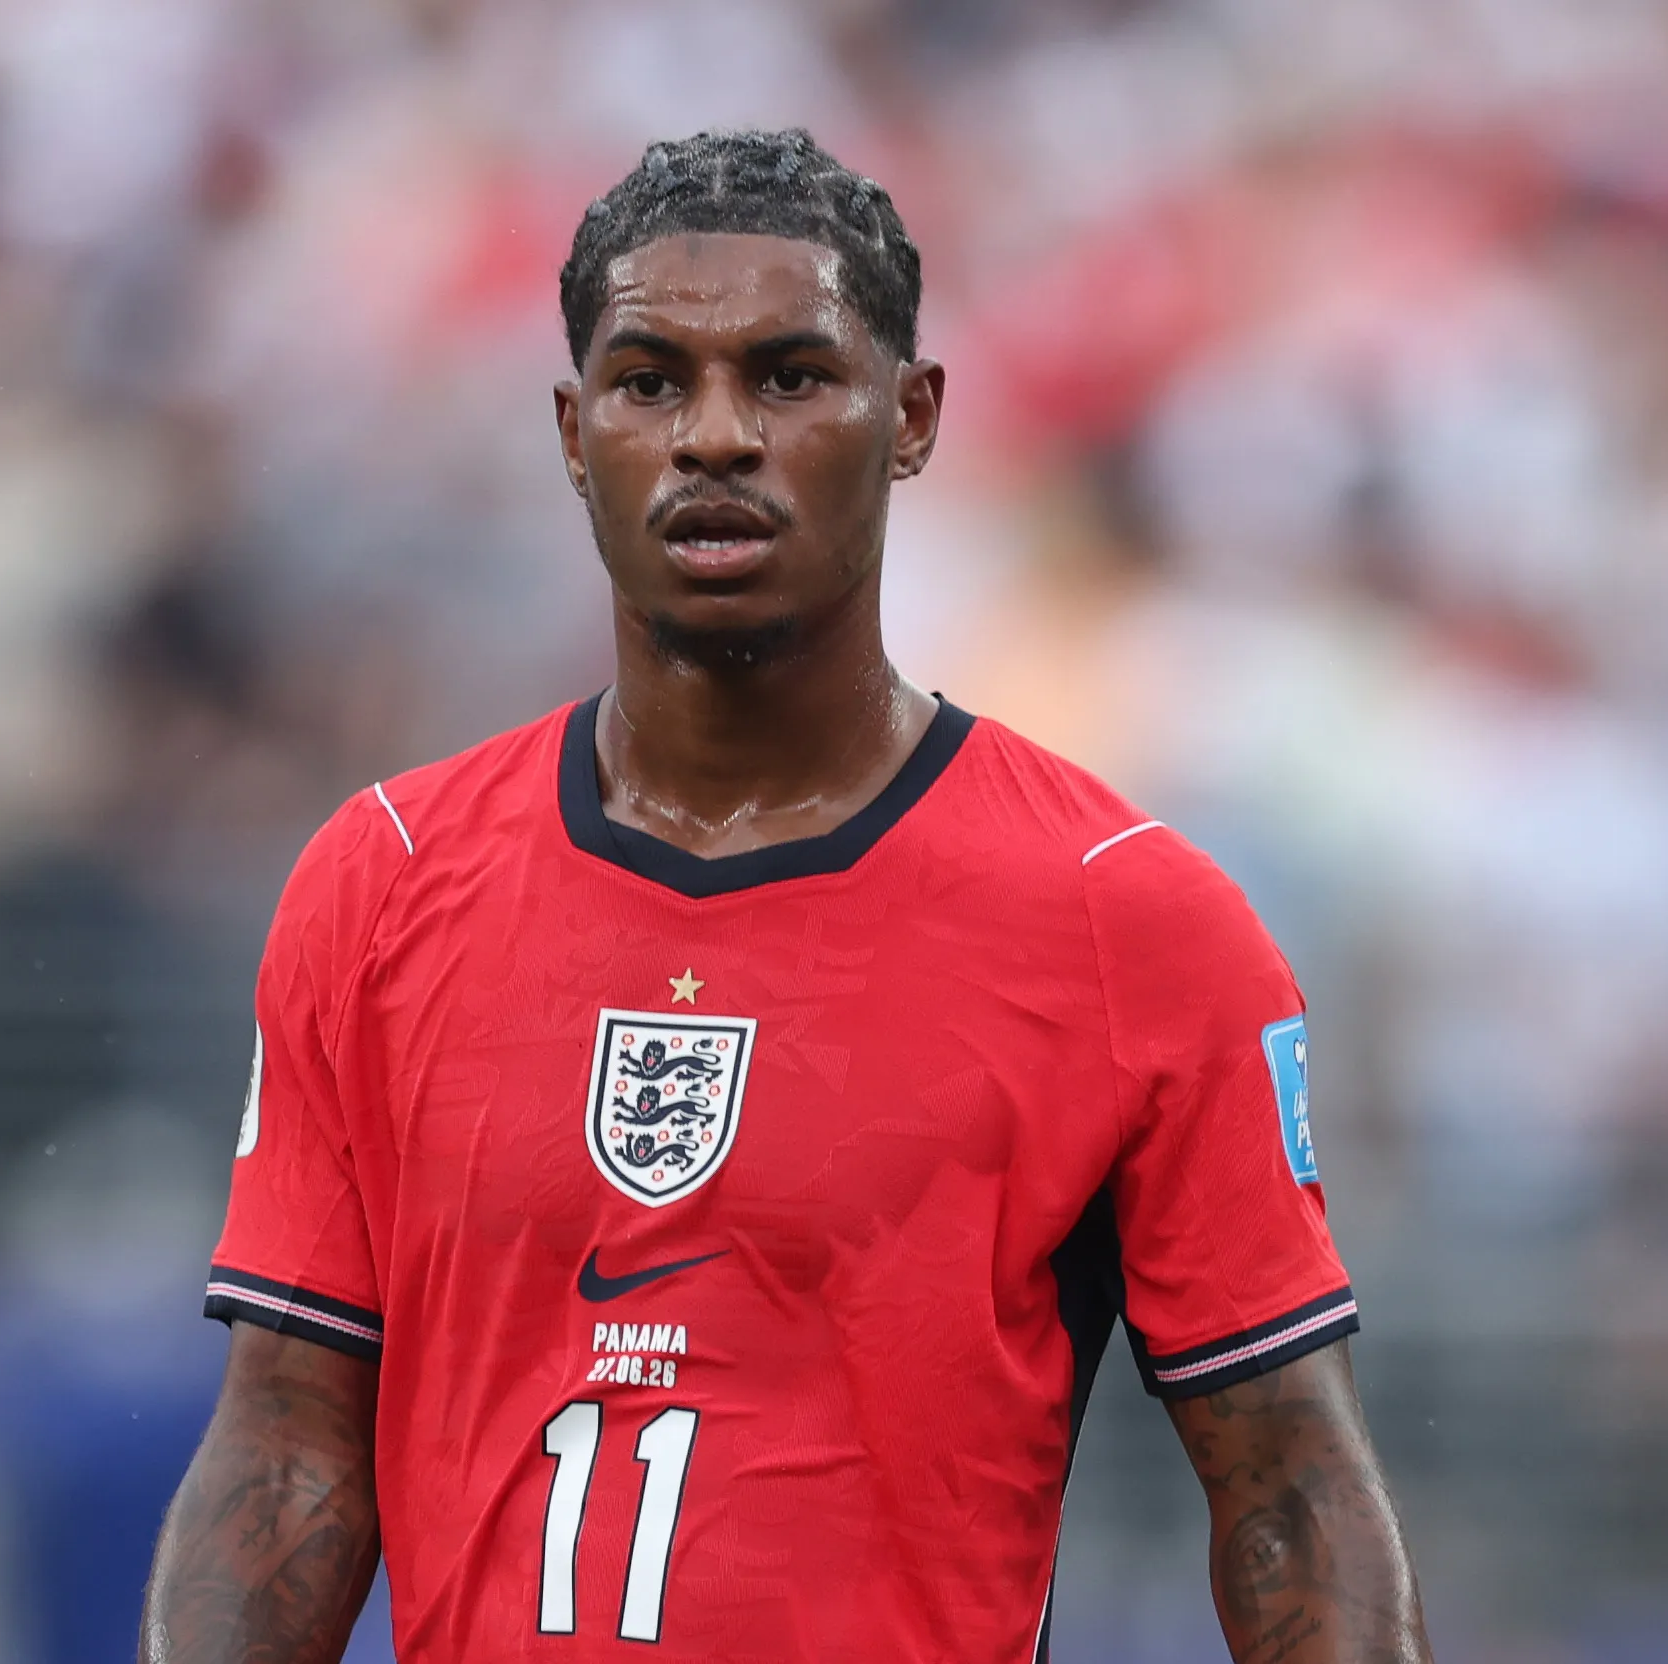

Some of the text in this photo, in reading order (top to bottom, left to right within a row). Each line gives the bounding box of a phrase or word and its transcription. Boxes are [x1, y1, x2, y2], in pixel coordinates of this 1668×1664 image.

[592, 1321, 687, 1355] PANAMA
[586, 1354, 678, 1389] 27.06.26
[536, 1400, 701, 1645] 11
